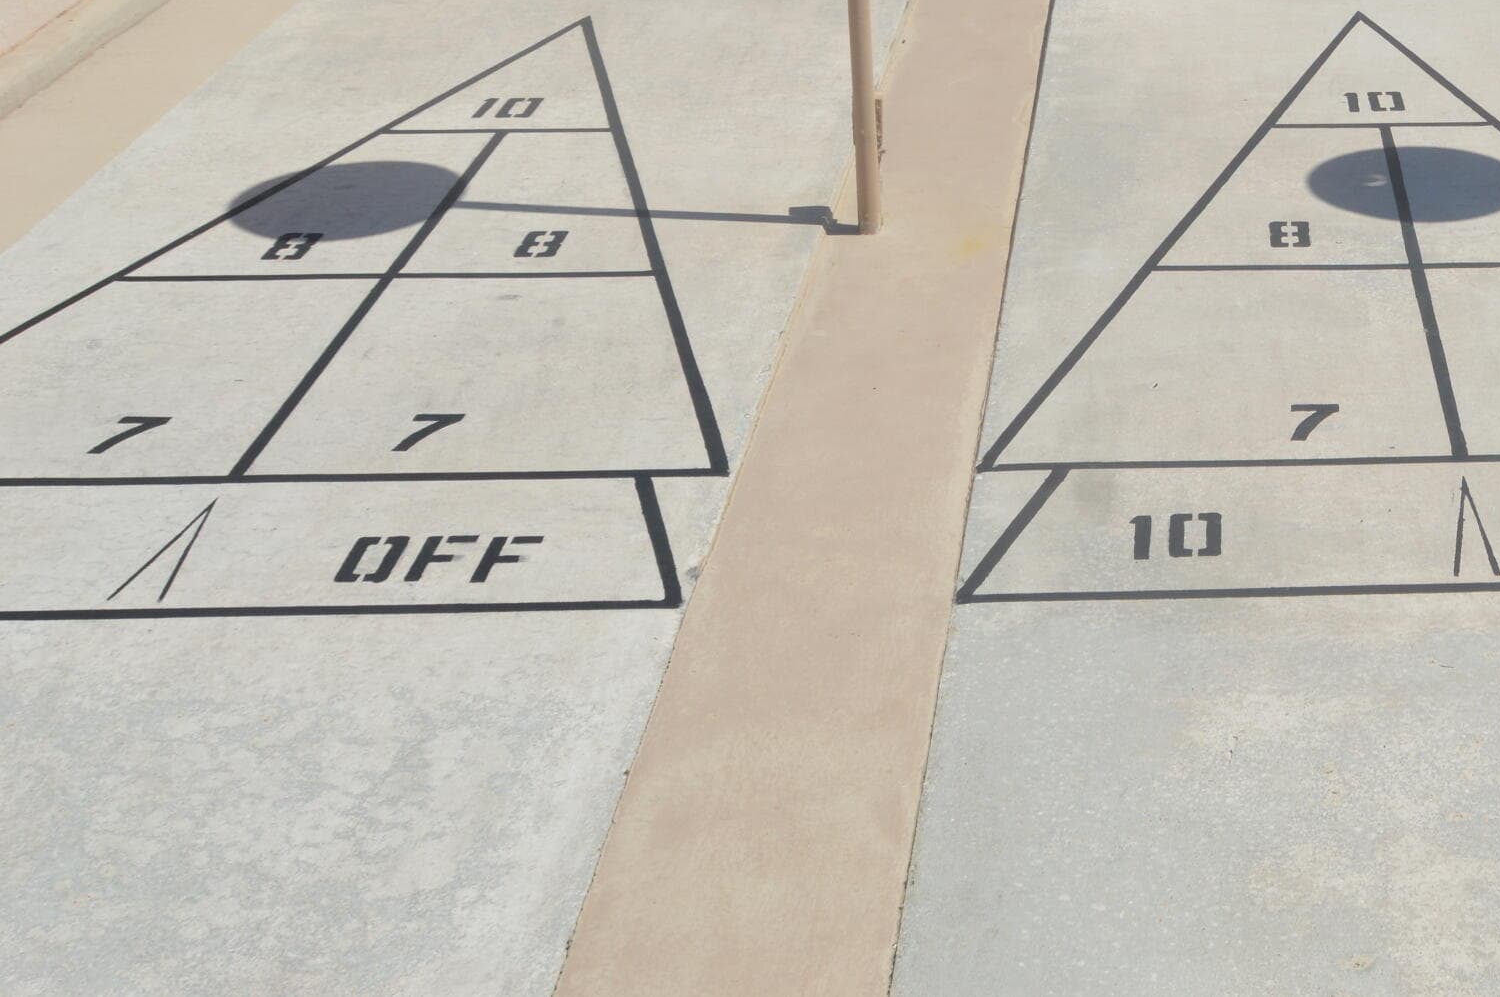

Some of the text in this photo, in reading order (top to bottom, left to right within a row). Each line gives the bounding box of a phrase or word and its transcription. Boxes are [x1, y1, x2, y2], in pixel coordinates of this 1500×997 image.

[471, 97, 545, 119] 10
[1343, 91, 1406, 113] 10
[260, 230, 569, 260] 8 8
[1268, 220, 1312, 249] 8
[86, 413, 466, 455] 7 7
[1290, 403, 1340, 442] 7
[1128, 512, 1223, 561] 10
[333, 535, 545, 584] OFF
